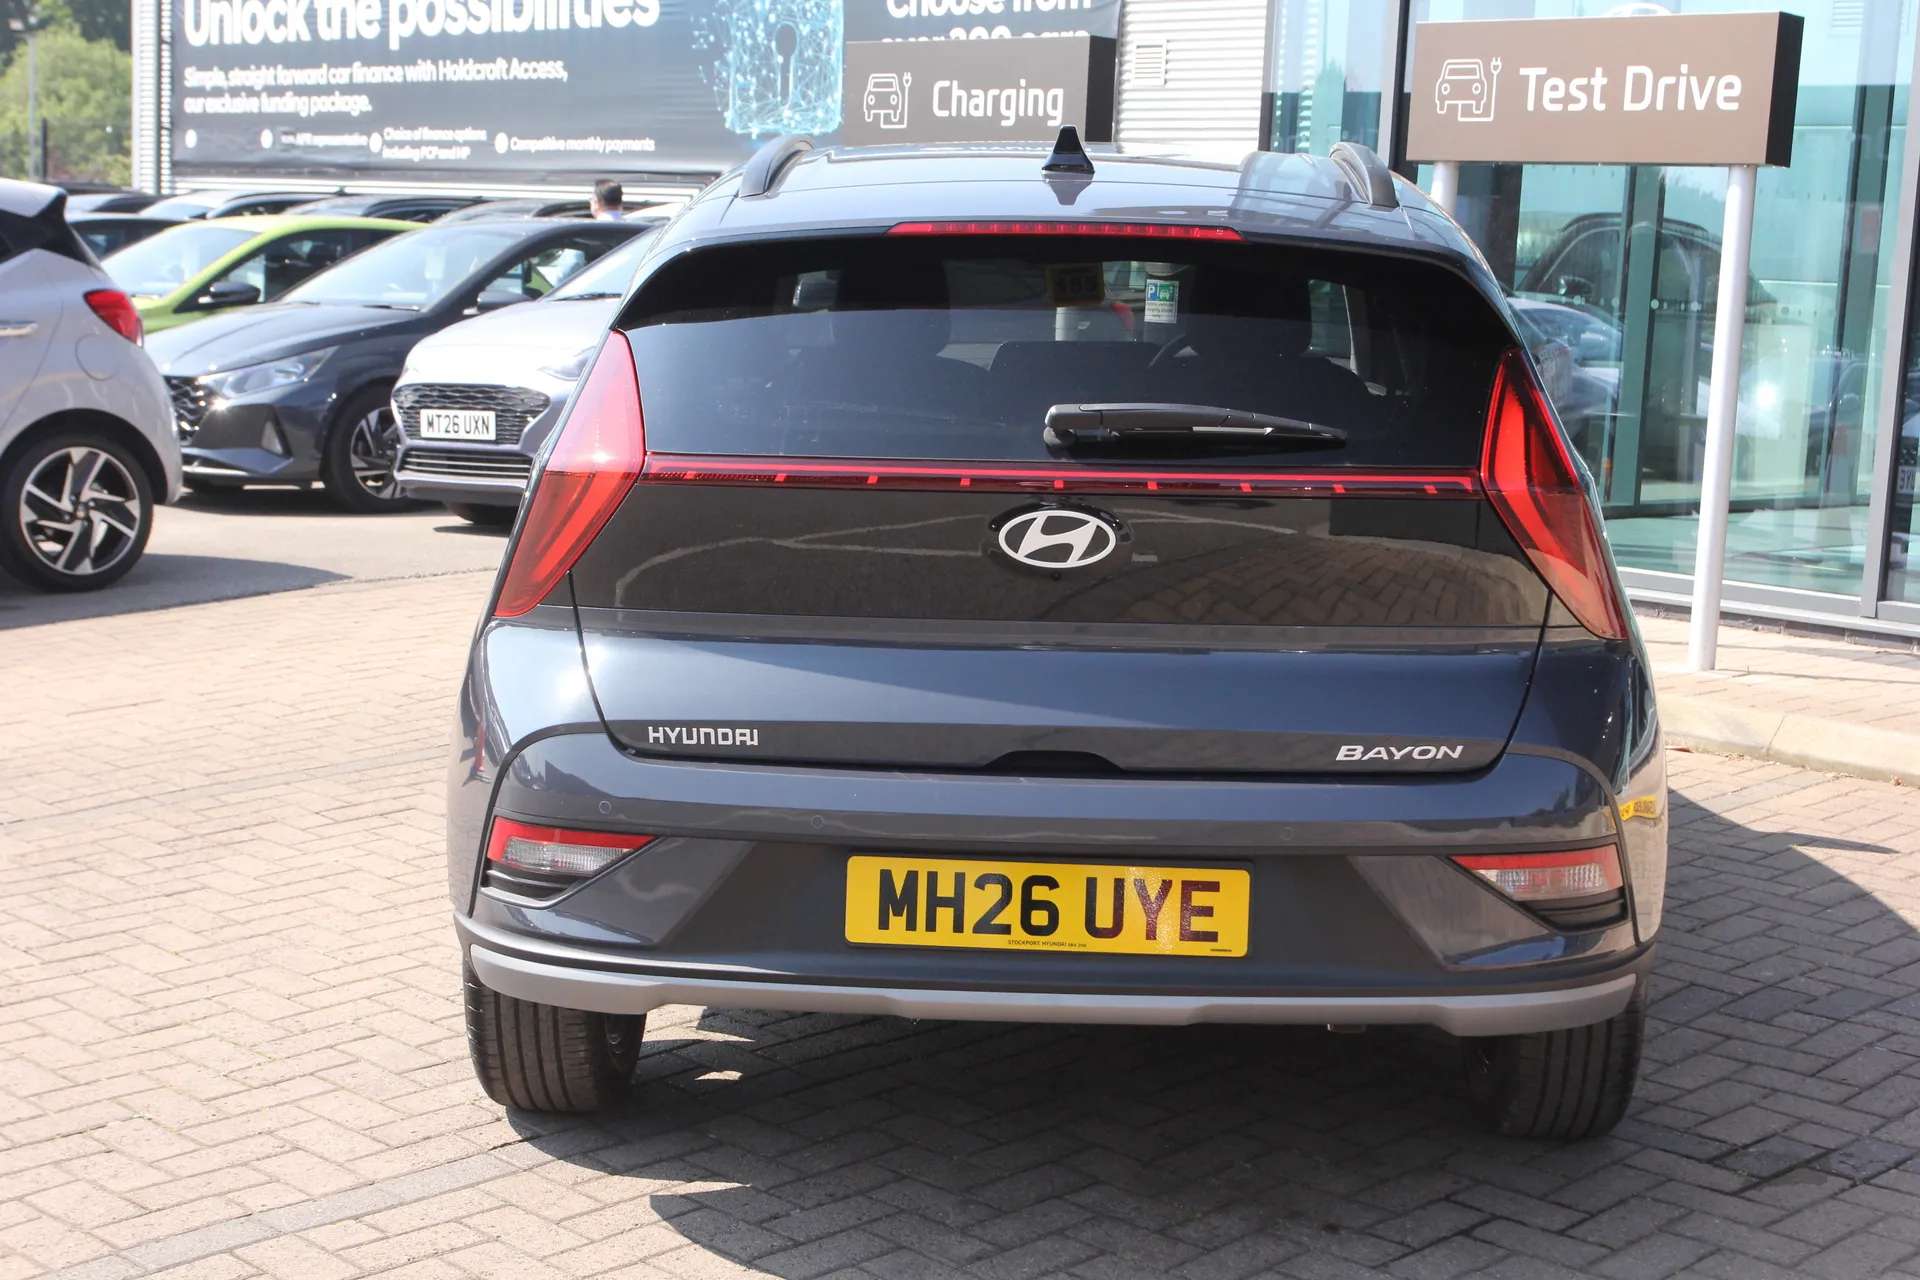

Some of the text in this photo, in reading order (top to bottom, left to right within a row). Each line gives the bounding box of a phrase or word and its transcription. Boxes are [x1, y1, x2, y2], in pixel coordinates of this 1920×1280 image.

[183, 0, 312, 47] Unlock
[276, 63, 328, 85] forward
[328, 67, 352, 85] car
[352, 61, 404, 84] finance
[404, 58, 437, 82] with
[438, 57, 508, 81] Holdcroft
[508, 57, 568, 82] Access,
[1519, 64, 1742, 112] Test Drive
[261, 91, 309, 117] funding
[932, 78, 1064, 127] Charging
[427, 414, 490, 435] MT26 UXN
[648, 726, 759, 746] HYUNDAI
[1335, 745, 1464, 761] BAYON
[878, 869, 1220, 943] MH26 UYE
